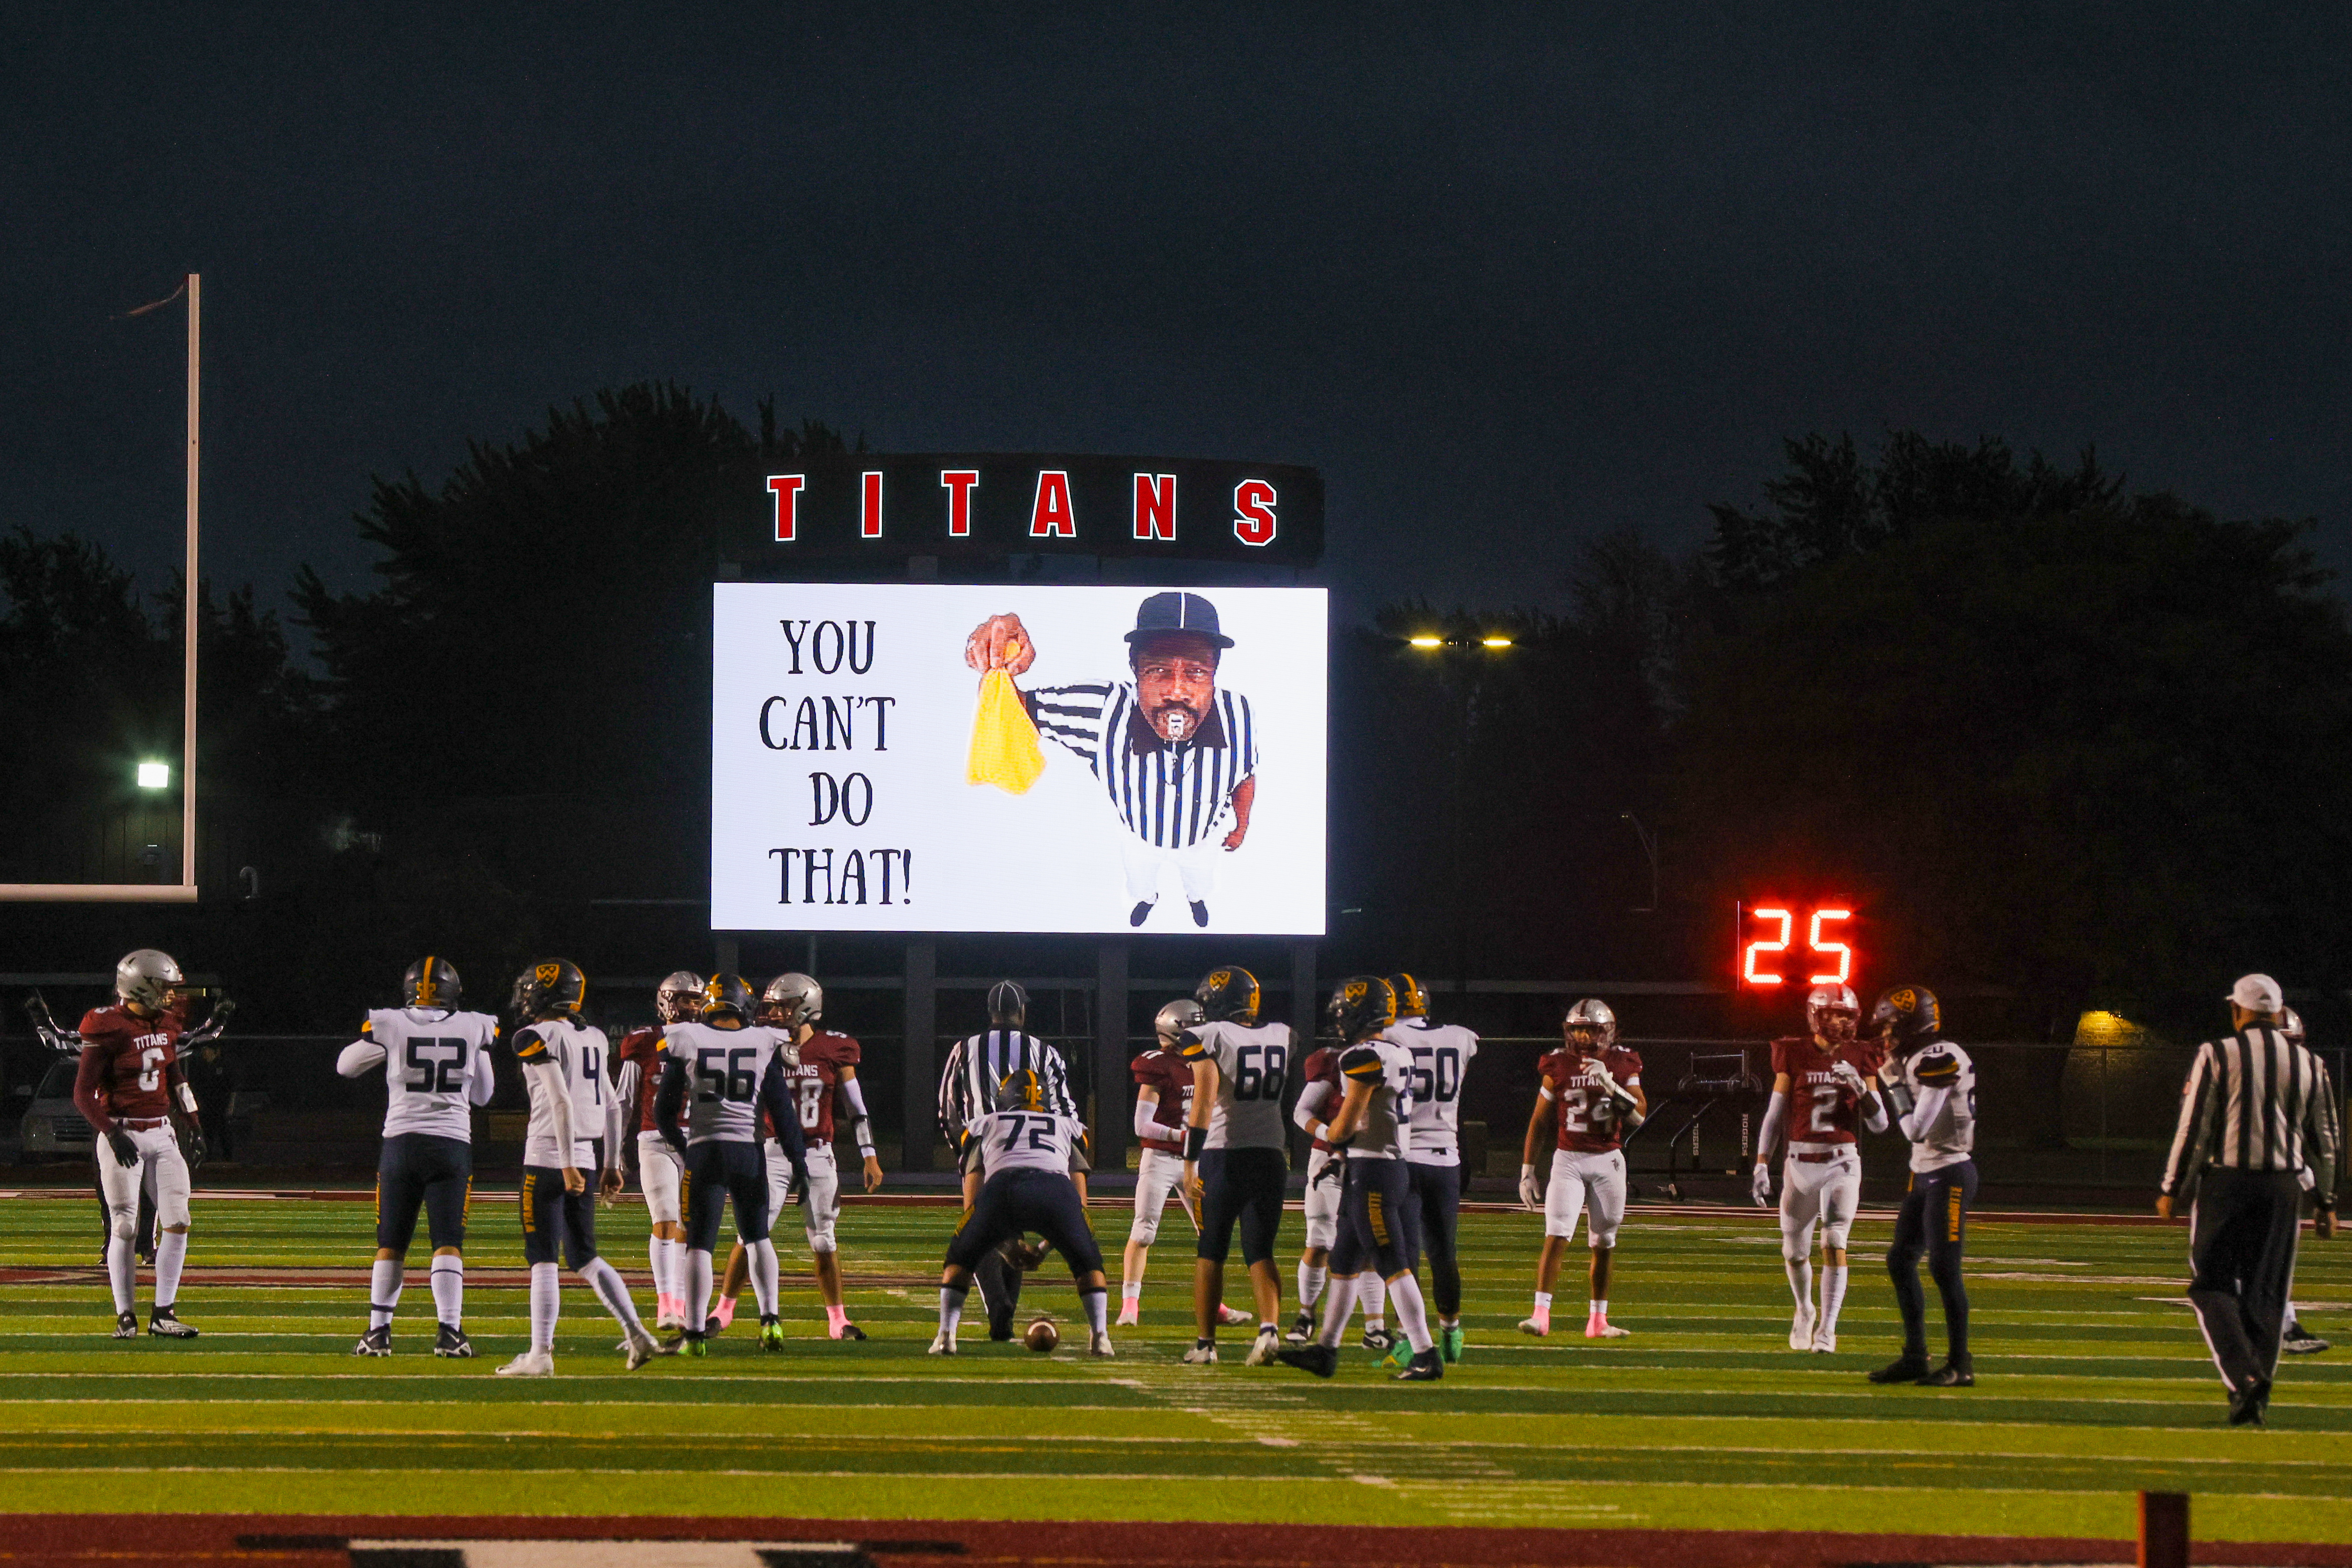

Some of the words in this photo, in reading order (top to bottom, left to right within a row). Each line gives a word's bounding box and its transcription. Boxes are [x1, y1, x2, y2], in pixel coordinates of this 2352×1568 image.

[767, 470, 1277, 546] TITANS
[779, 620, 876, 675] YOU
[759, 696, 896, 751] CAN'T
[808, 772, 873, 827] DO
[769, 848, 912, 905] THAT!
[1744, 909, 1851, 984] 25
[134, 1033, 168, 1049] TITANS
[406, 1037, 467, 1093] 52
[138, 1047, 166, 1091] 6
[583, 1046, 601, 1105] 4
[697, 1048, 757, 1102] 56
[1233, 1045, 1286, 1101] 68
[1408, 1047, 1459, 1102] 50
[1570, 1075, 1600, 1088] TITA
[997, 1114, 1056, 1153] 72
[1811, 1085, 1838, 1132] 2
